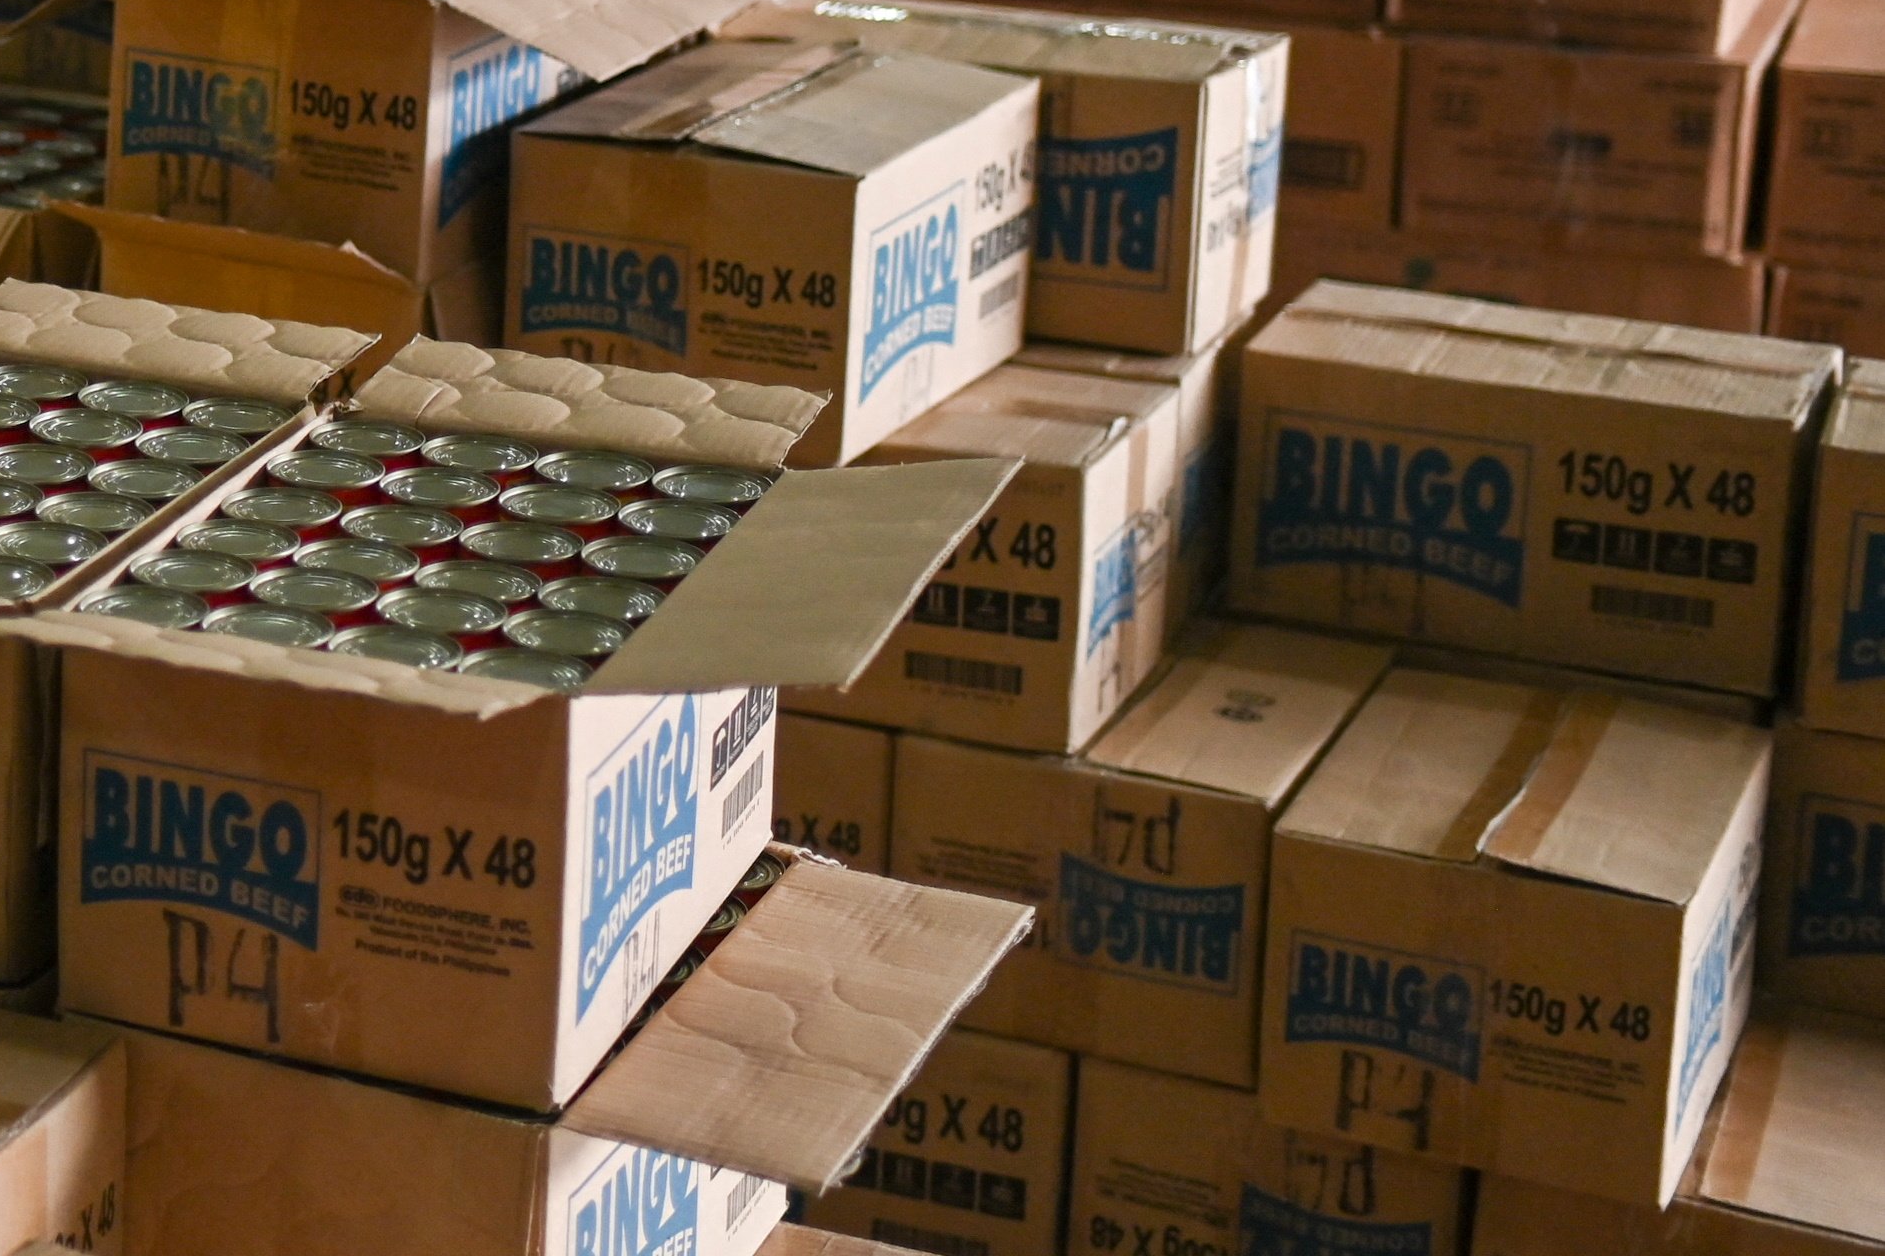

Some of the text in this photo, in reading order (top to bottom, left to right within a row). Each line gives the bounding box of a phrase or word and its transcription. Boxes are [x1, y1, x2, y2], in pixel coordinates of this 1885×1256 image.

[131, 61, 269, 137] BINGO
[290, 79, 418, 131] 150g X 48
[452, 43, 542, 146] BINGO
[976, 162, 1004, 212] 150g
[1036, 184, 1156, 272] BIN
[530, 238, 679, 310] BINGO
[698, 258, 837, 310] 150g X 48
[873, 203, 958, 334] BINGO
[528, 304, 619, 324] CORNED
[865, 311, 921, 383] CORNED
[923, 304, 955, 333] BEEF
[1275, 428, 1513, 537] BINGO
[1557, 451, 1757, 519] 150g X 48
[971, 517, 1057, 572] X 48
[1267, 525, 1514, 584] CORNED BEEF
[92, 765, 309, 880] BINGO
[591, 692, 696, 899] BINGO
[332, 807, 536, 890] 150g X 48
[800, 813, 822, 850] X
[827, 821, 862, 857] 48
[89, 864, 219, 897] CORNED
[231, 878, 309, 930] BEEF
[583, 833, 693, 991] CORNED BEEF
[1068, 902, 1237, 983] BINGO
[1298, 944, 1472, 1031] BINGO
[1490, 978, 1651, 1042] 150g X 48
[1294, 1012, 1399, 1040] CORNED
[939, 1094, 968, 1144] X
[977, 1104, 1025, 1153] 48
[97, 1181, 115, 1238] 48
